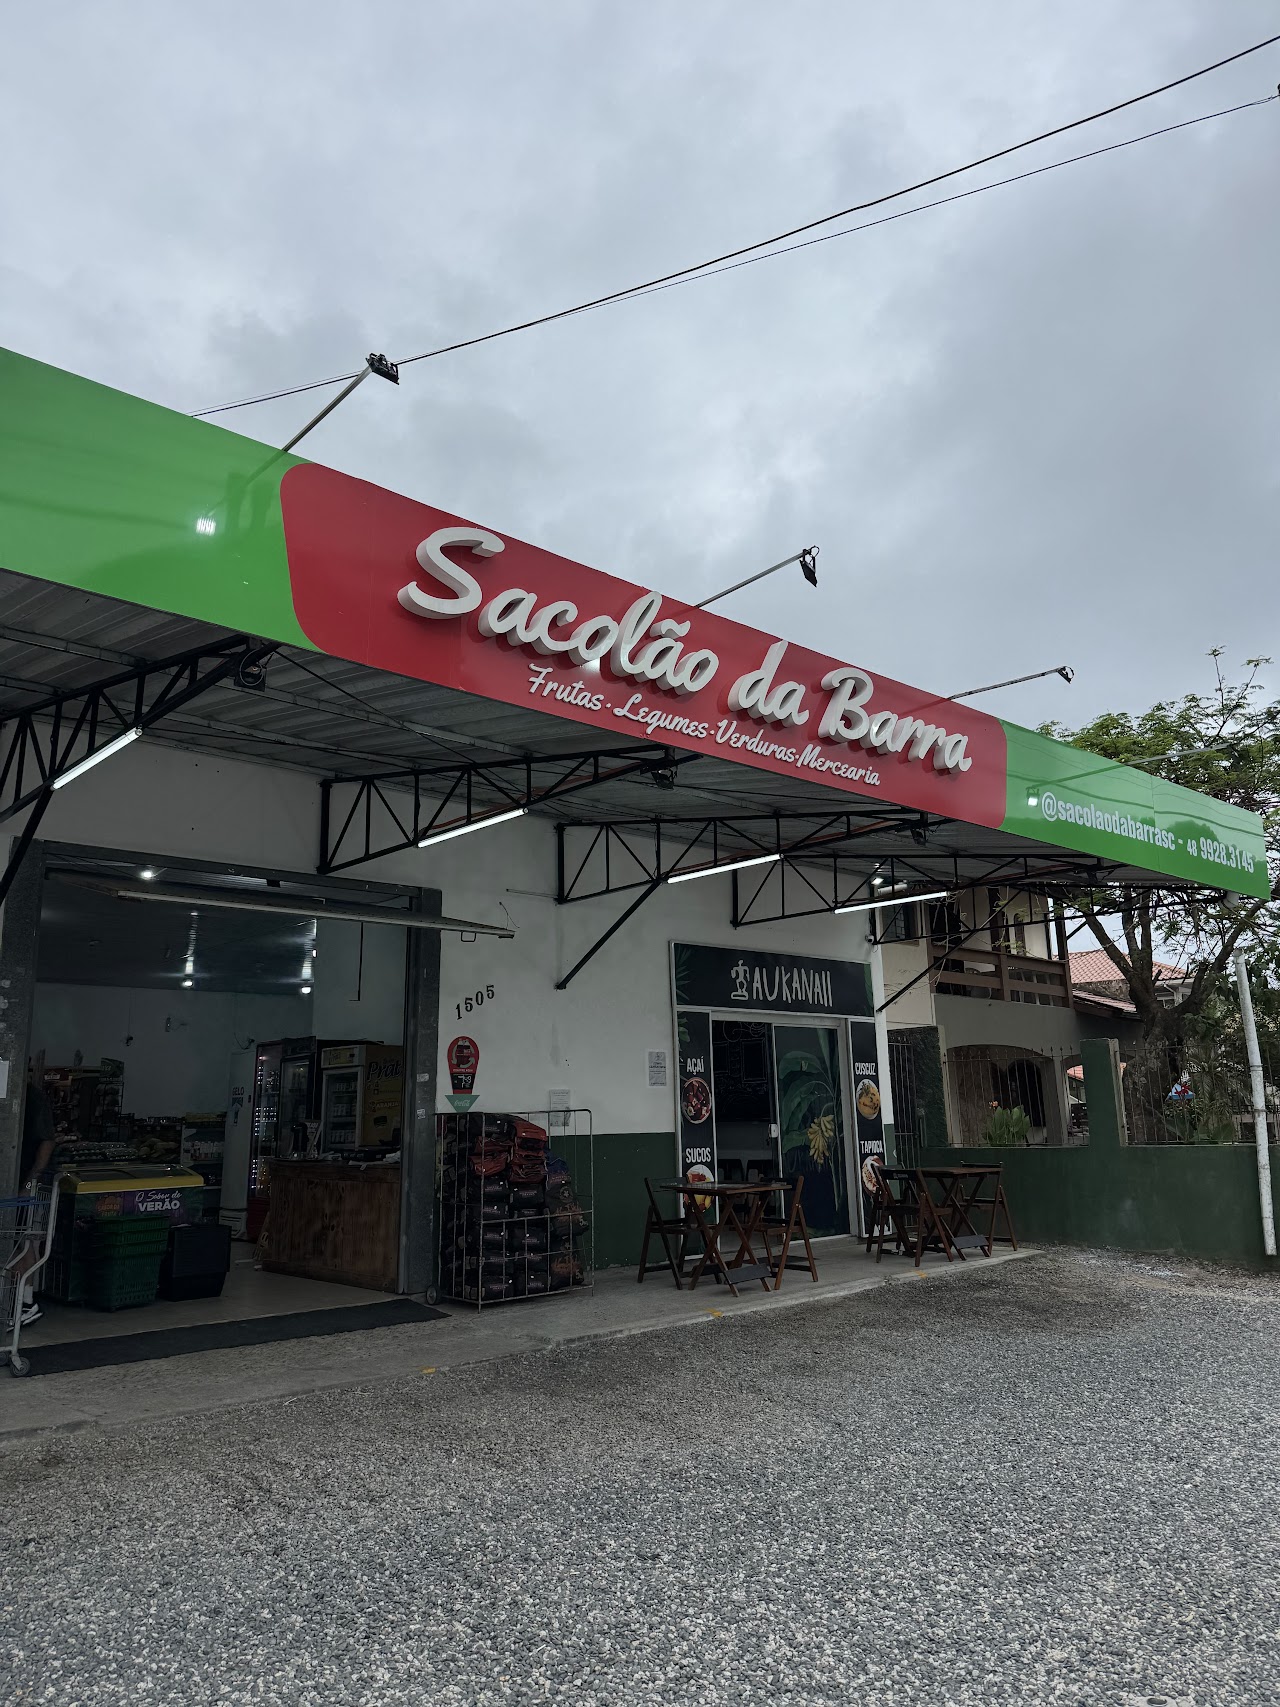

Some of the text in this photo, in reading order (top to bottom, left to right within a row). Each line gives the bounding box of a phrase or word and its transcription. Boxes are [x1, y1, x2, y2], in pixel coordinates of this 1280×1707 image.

[397, 527, 973, 774] Sacolão da Barra
[528, 663, 881, 786] Frutas Legumes Verduras Mercearia
[1041, 791, 1176, 851] @sacolaodabarrasc
[1186, 838, 1198, 857] 48
[1199, 836, 1255, 874] 9928.3145
[456, 984, 495, 1021] 1505
[686, 1055, 705, 1075] AÇAÍ
[855, 1063, 879, 1077] CUSCUZ
[685, 1147, 712, 1164] SUCOS
[860, 1140, 887, 1154] TAPIOCA
[138, 1198, 181, 1212] VERÃO
